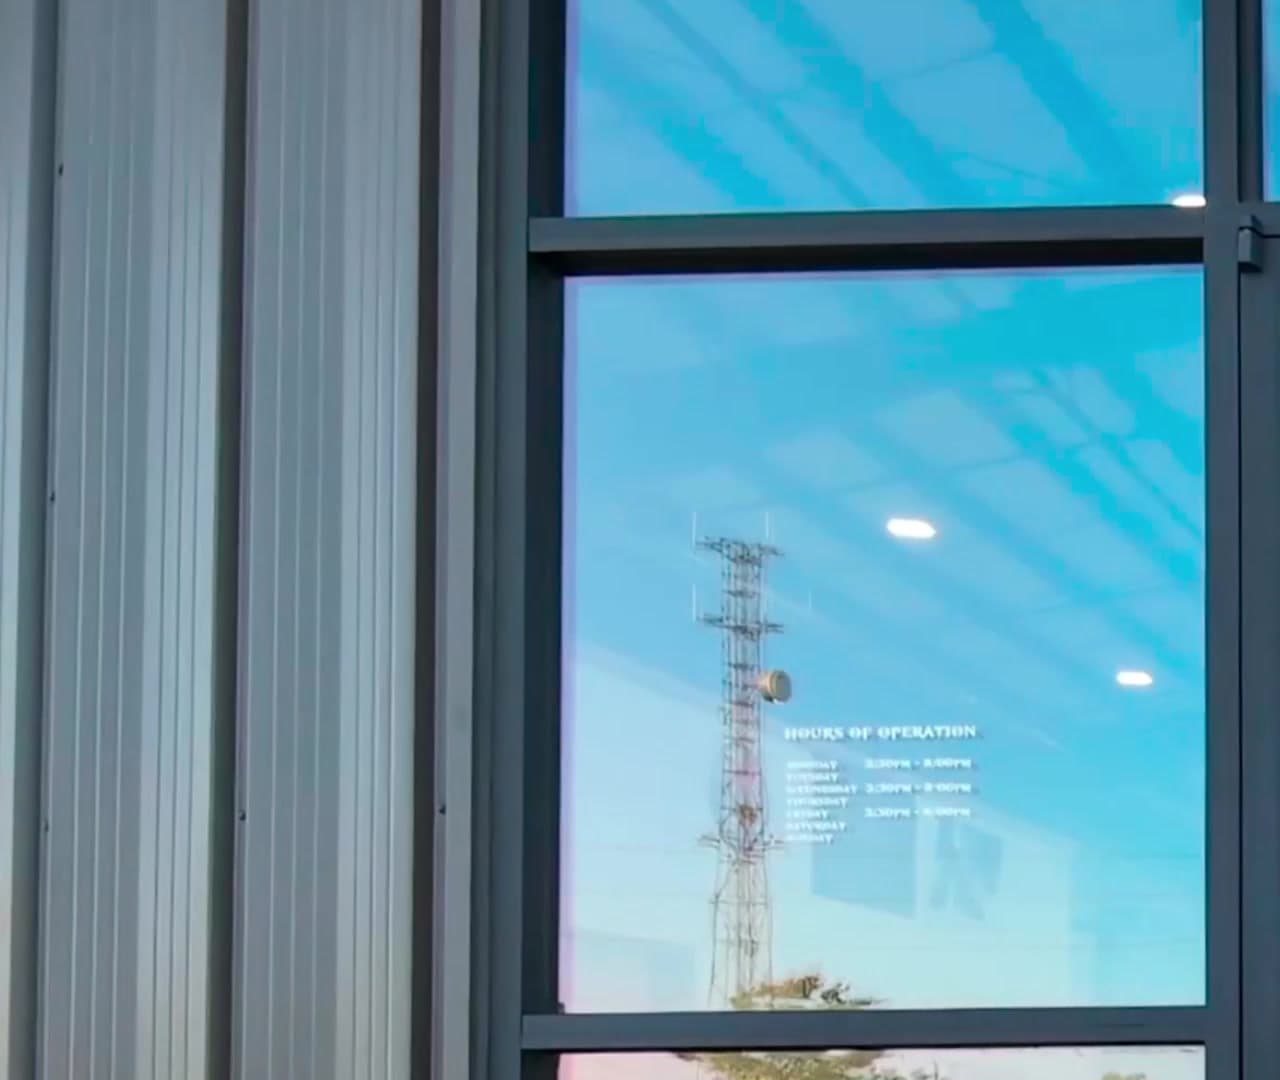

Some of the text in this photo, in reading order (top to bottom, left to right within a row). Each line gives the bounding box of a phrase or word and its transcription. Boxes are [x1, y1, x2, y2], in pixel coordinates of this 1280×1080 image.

[784, 725, 977, 741] HOURS OF OPERATION
